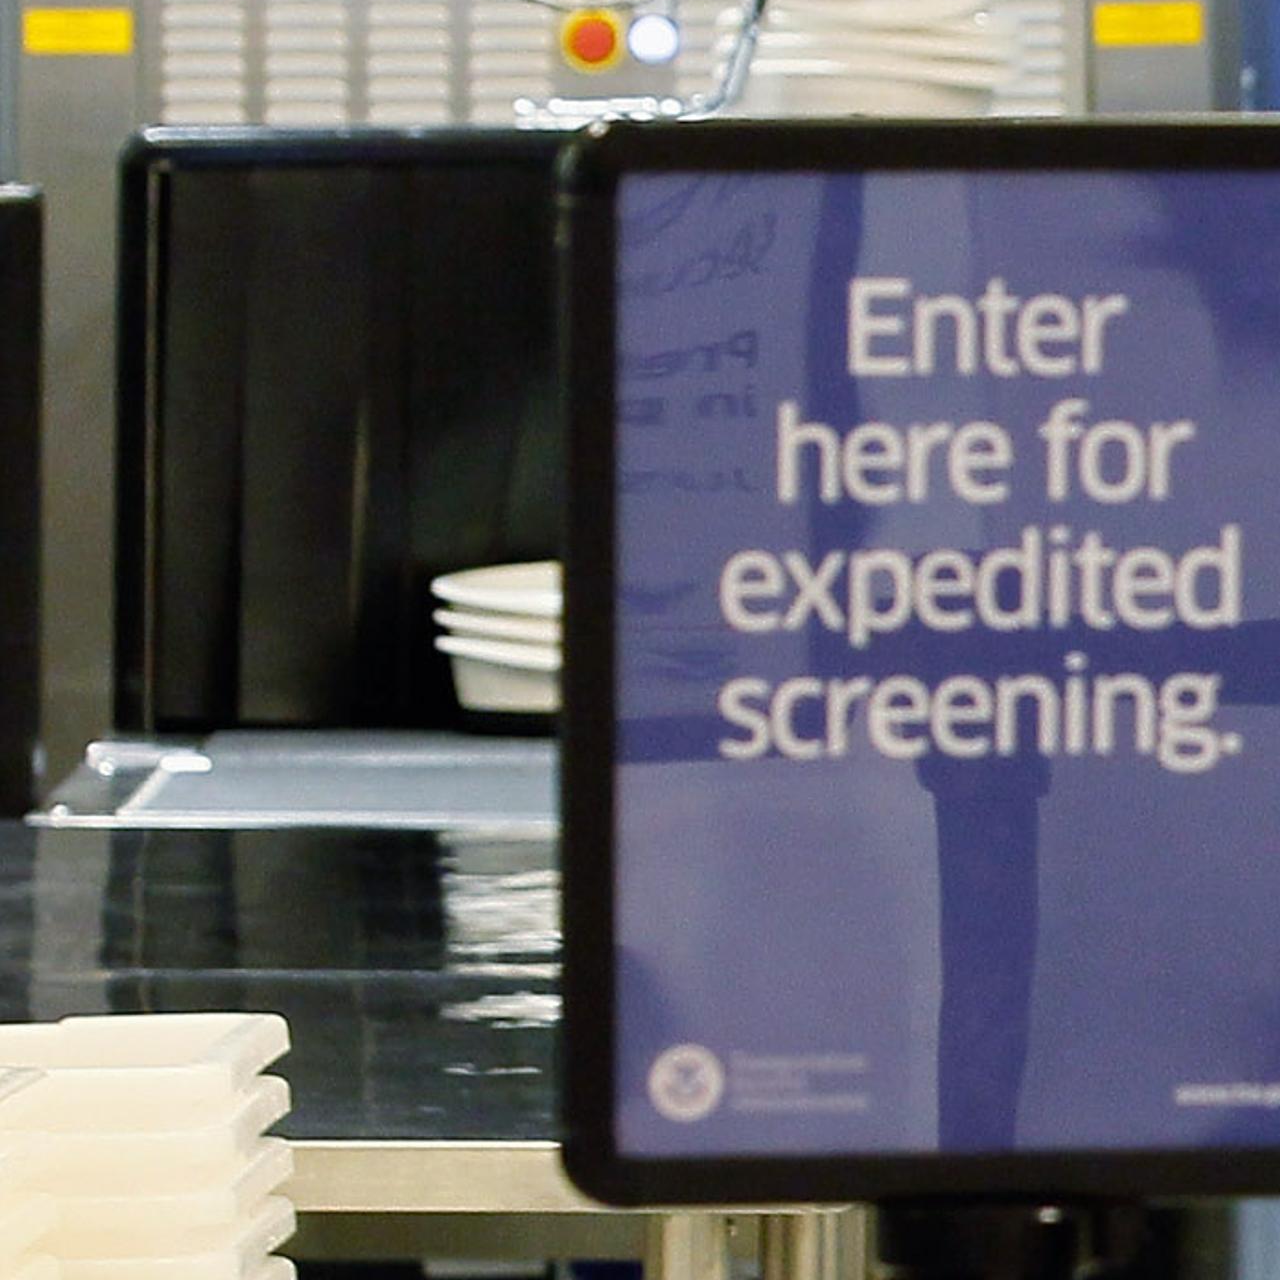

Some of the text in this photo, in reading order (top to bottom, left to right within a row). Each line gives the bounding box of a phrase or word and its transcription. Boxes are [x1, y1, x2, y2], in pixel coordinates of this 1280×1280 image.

[847, 276, 1129, 378] Enter
[776, 397, 1196, 506] here for
[718, 522, 1243, 649] expedited
[716, 650, 1243, 774] screening.
